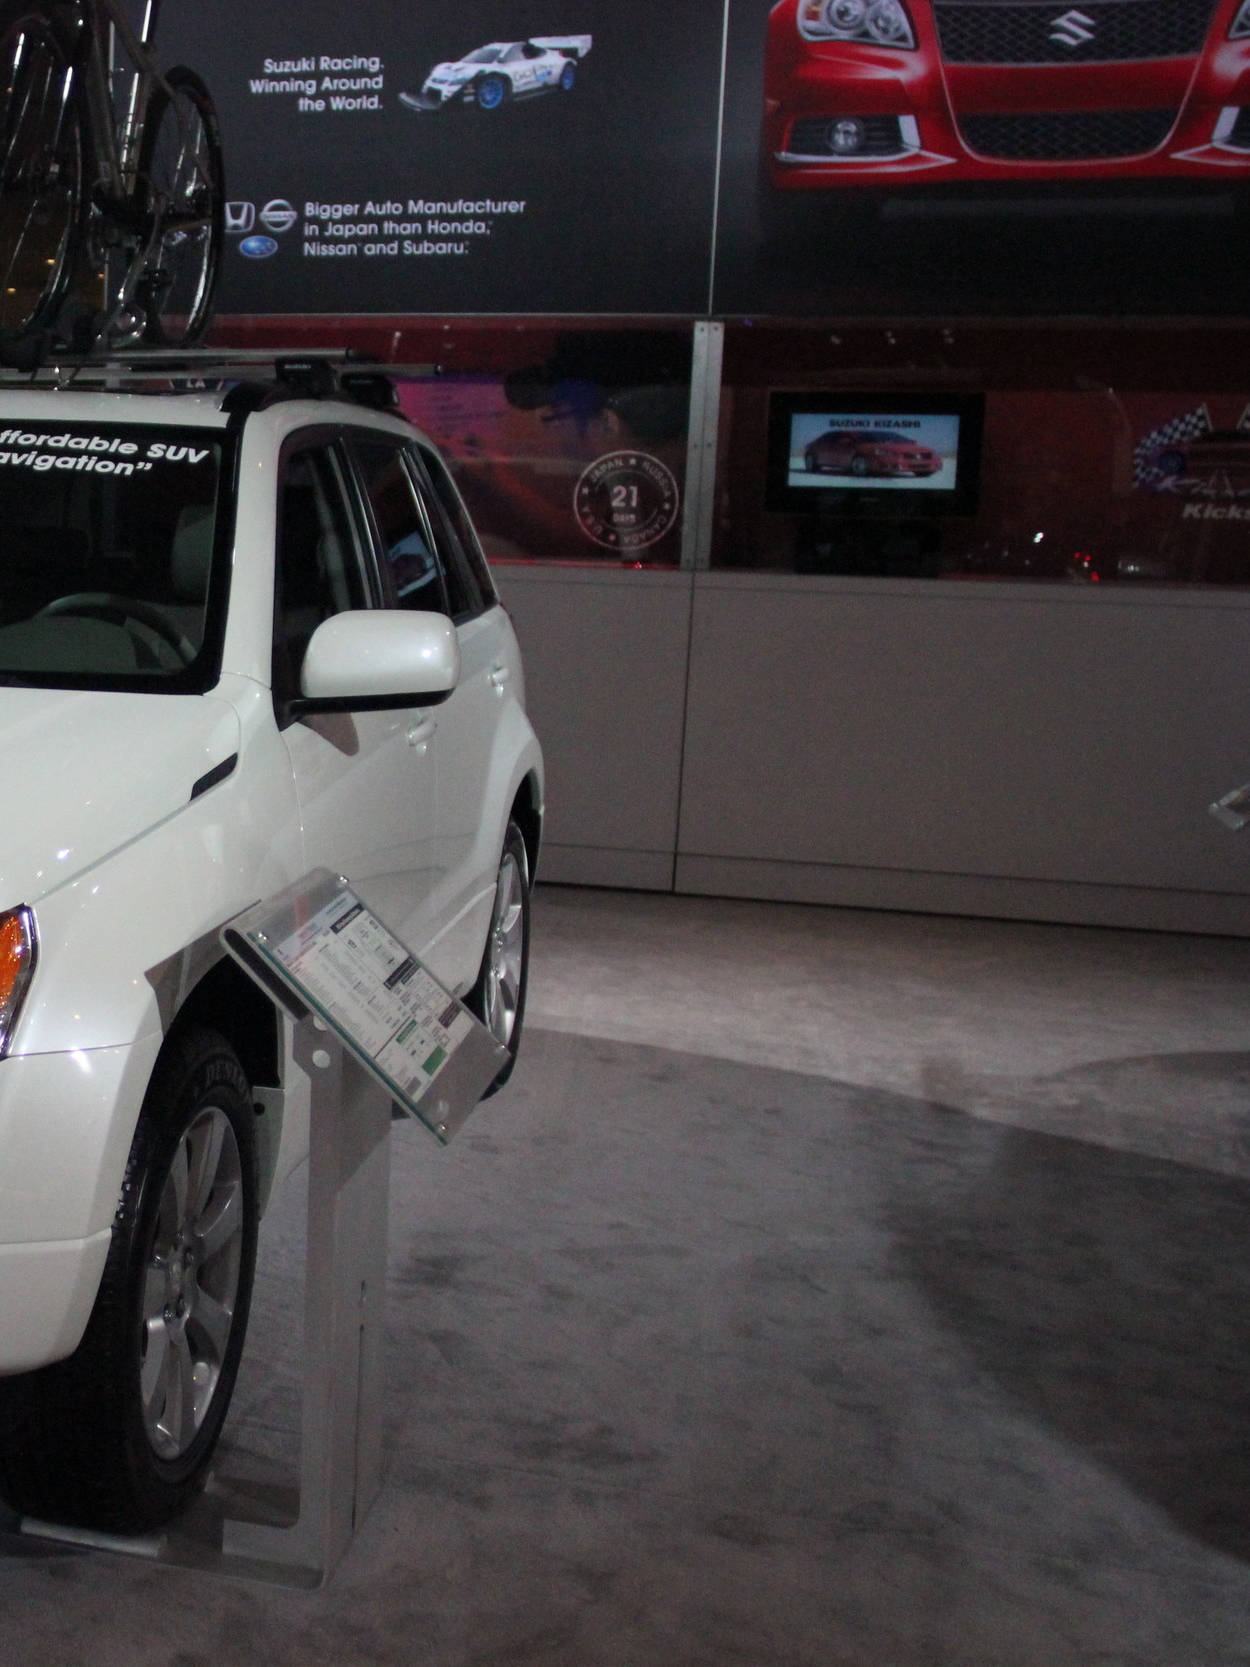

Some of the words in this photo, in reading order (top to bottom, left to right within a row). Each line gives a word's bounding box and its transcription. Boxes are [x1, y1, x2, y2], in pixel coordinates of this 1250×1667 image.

[264, 57, 315, 73] Suzuki
[320, 55, 384, 72] Racing.
[250, 78, 317, 95] Winning
[321, 74, 384, 91] Around
[298, 97, 326, 112] the
[330, 94, 383, 110] World.
[304, 202, 360, 219] Bigger
[364, 200, 403, 215] Auto
[408, 199, 526, 214] Manufacturer
[304, 222, 319, 236] in
[324, 221, 379, 238] Japan
[383, 220, 422, 235] than
[364, 240, 398, 255] and
[146, 443, 210, 464] SUV
[591, 458, 623, 483] JAPAN
[643, 460, 671, 498] RUSSIA
[611, 484, 638, 508] 21
[612, 513, 637, 524] DAYS
